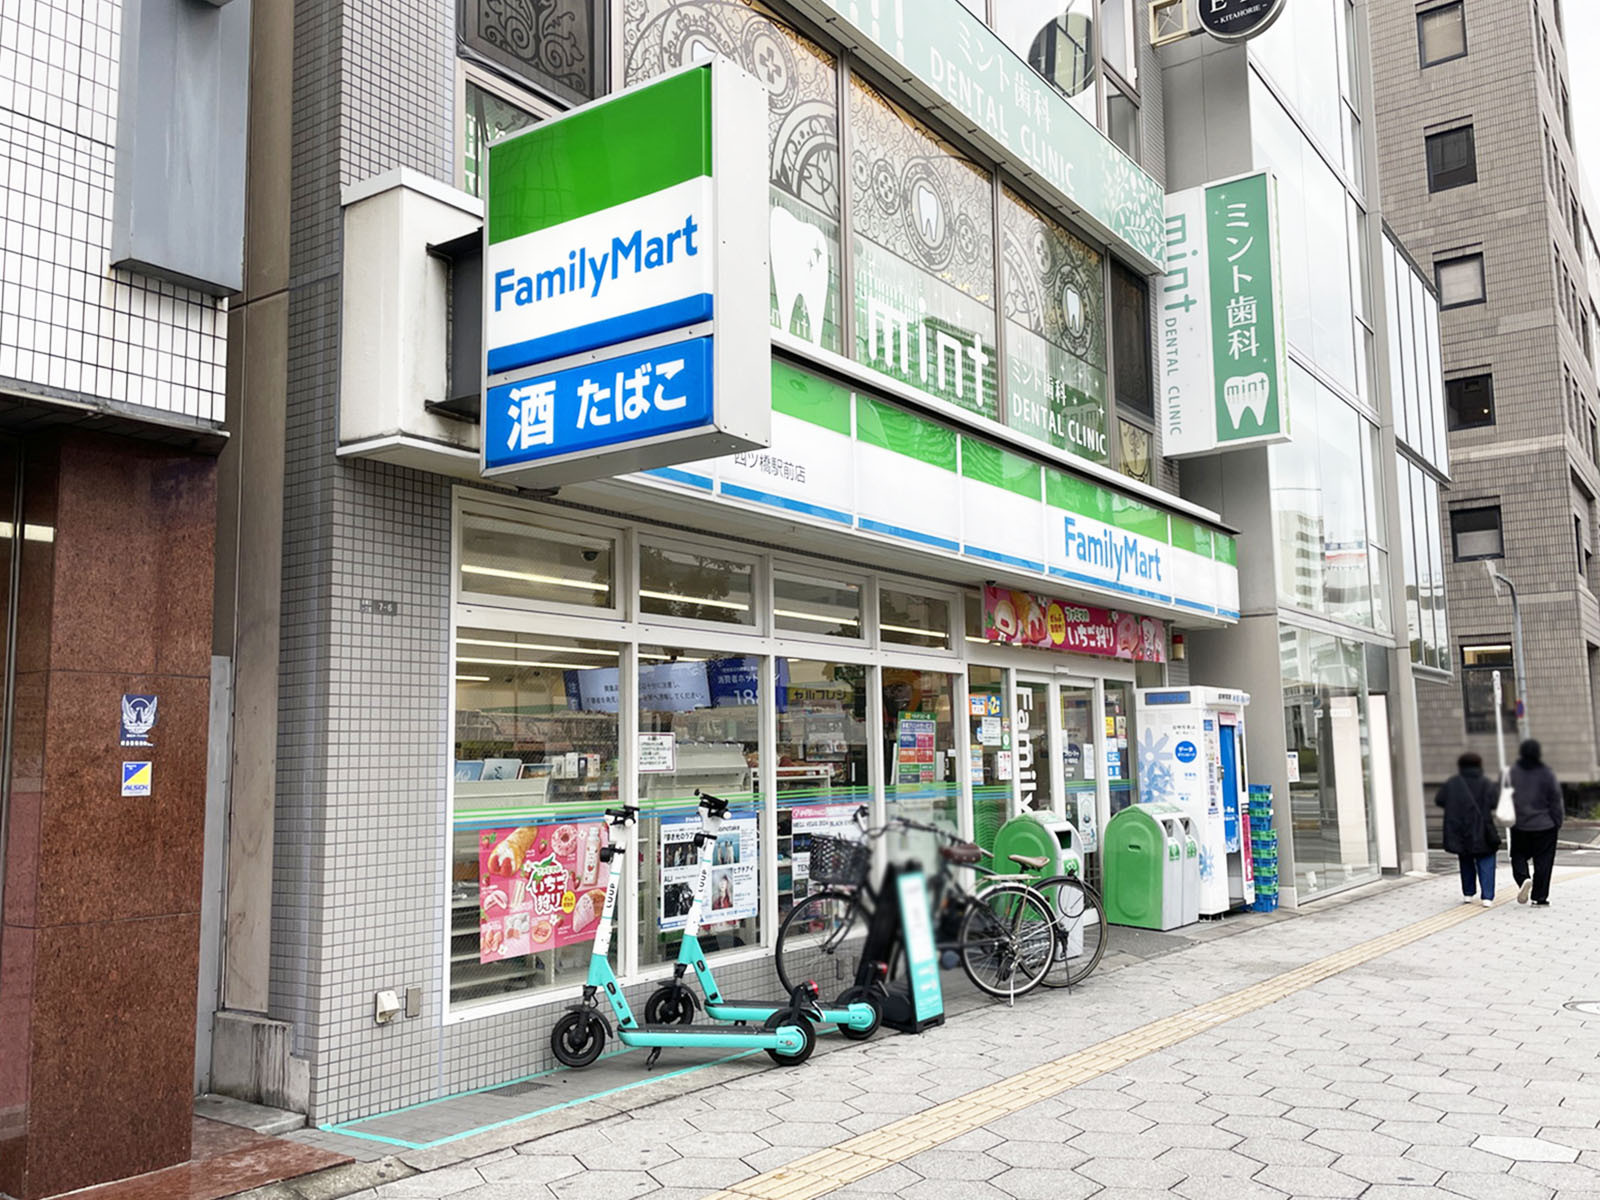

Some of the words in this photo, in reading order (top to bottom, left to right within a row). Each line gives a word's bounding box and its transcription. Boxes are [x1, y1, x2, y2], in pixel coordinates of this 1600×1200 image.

[1219, 5, 1261, 24] KITAHORIE
[957, 20, 1051, 135] ミント歯科
[930, 46, 1010, 139] DENTAL
[1020, 124, 1075, 193] CLINIC
[494, 213, 699, 313] FamilyMart
[1164, 213, 1199, 313] mint
[1226, 202, 1260, 360] ミント歯科
[867, 296, 990, 409] mint
[1164, 317, 1179, 376] DENTAL
[506, 380, 557, 451] 酒
[576, 358, 688, 430] たばこ
[1012, 357, 1067, 406] ミント歯科
[1168, 385, 1181, 434] CLINIC
[1226, 379, 1267, 396] mint
[1012, 392, 1065, 437] DENTAL
[1067, 419, 1107, 456] CLINIC
[734, 451, 806, 483] 四ツ橋駅前店
[1064, 515, 1162, 582] FamilyMart
[1067, 623, 1114, 648] いちご狩り
[605, 883, 616, 909] LUUP
[698, 869, 708, 893] LUUP
